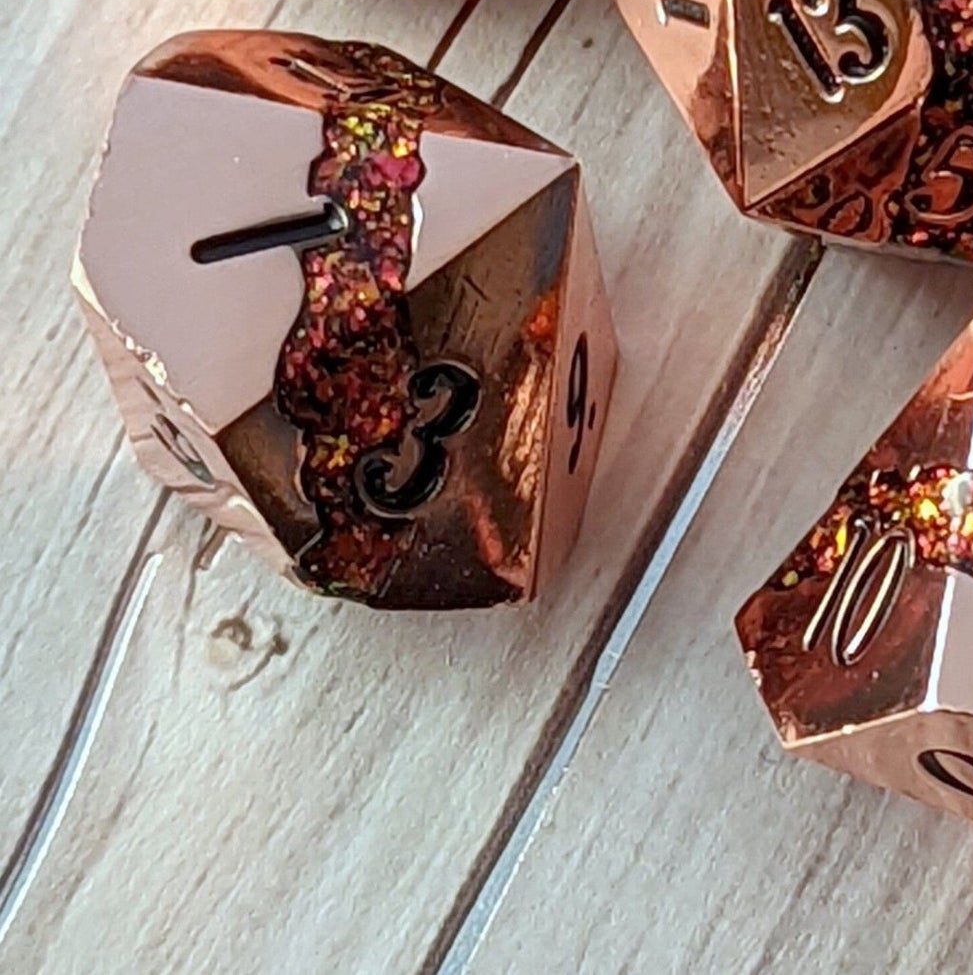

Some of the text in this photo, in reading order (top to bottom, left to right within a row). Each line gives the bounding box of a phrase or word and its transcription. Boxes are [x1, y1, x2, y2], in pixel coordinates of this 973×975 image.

[189, 198, 349, 265] 1
[357, 362, 480, 514] 3
[802, 518, 916, 667] 10
